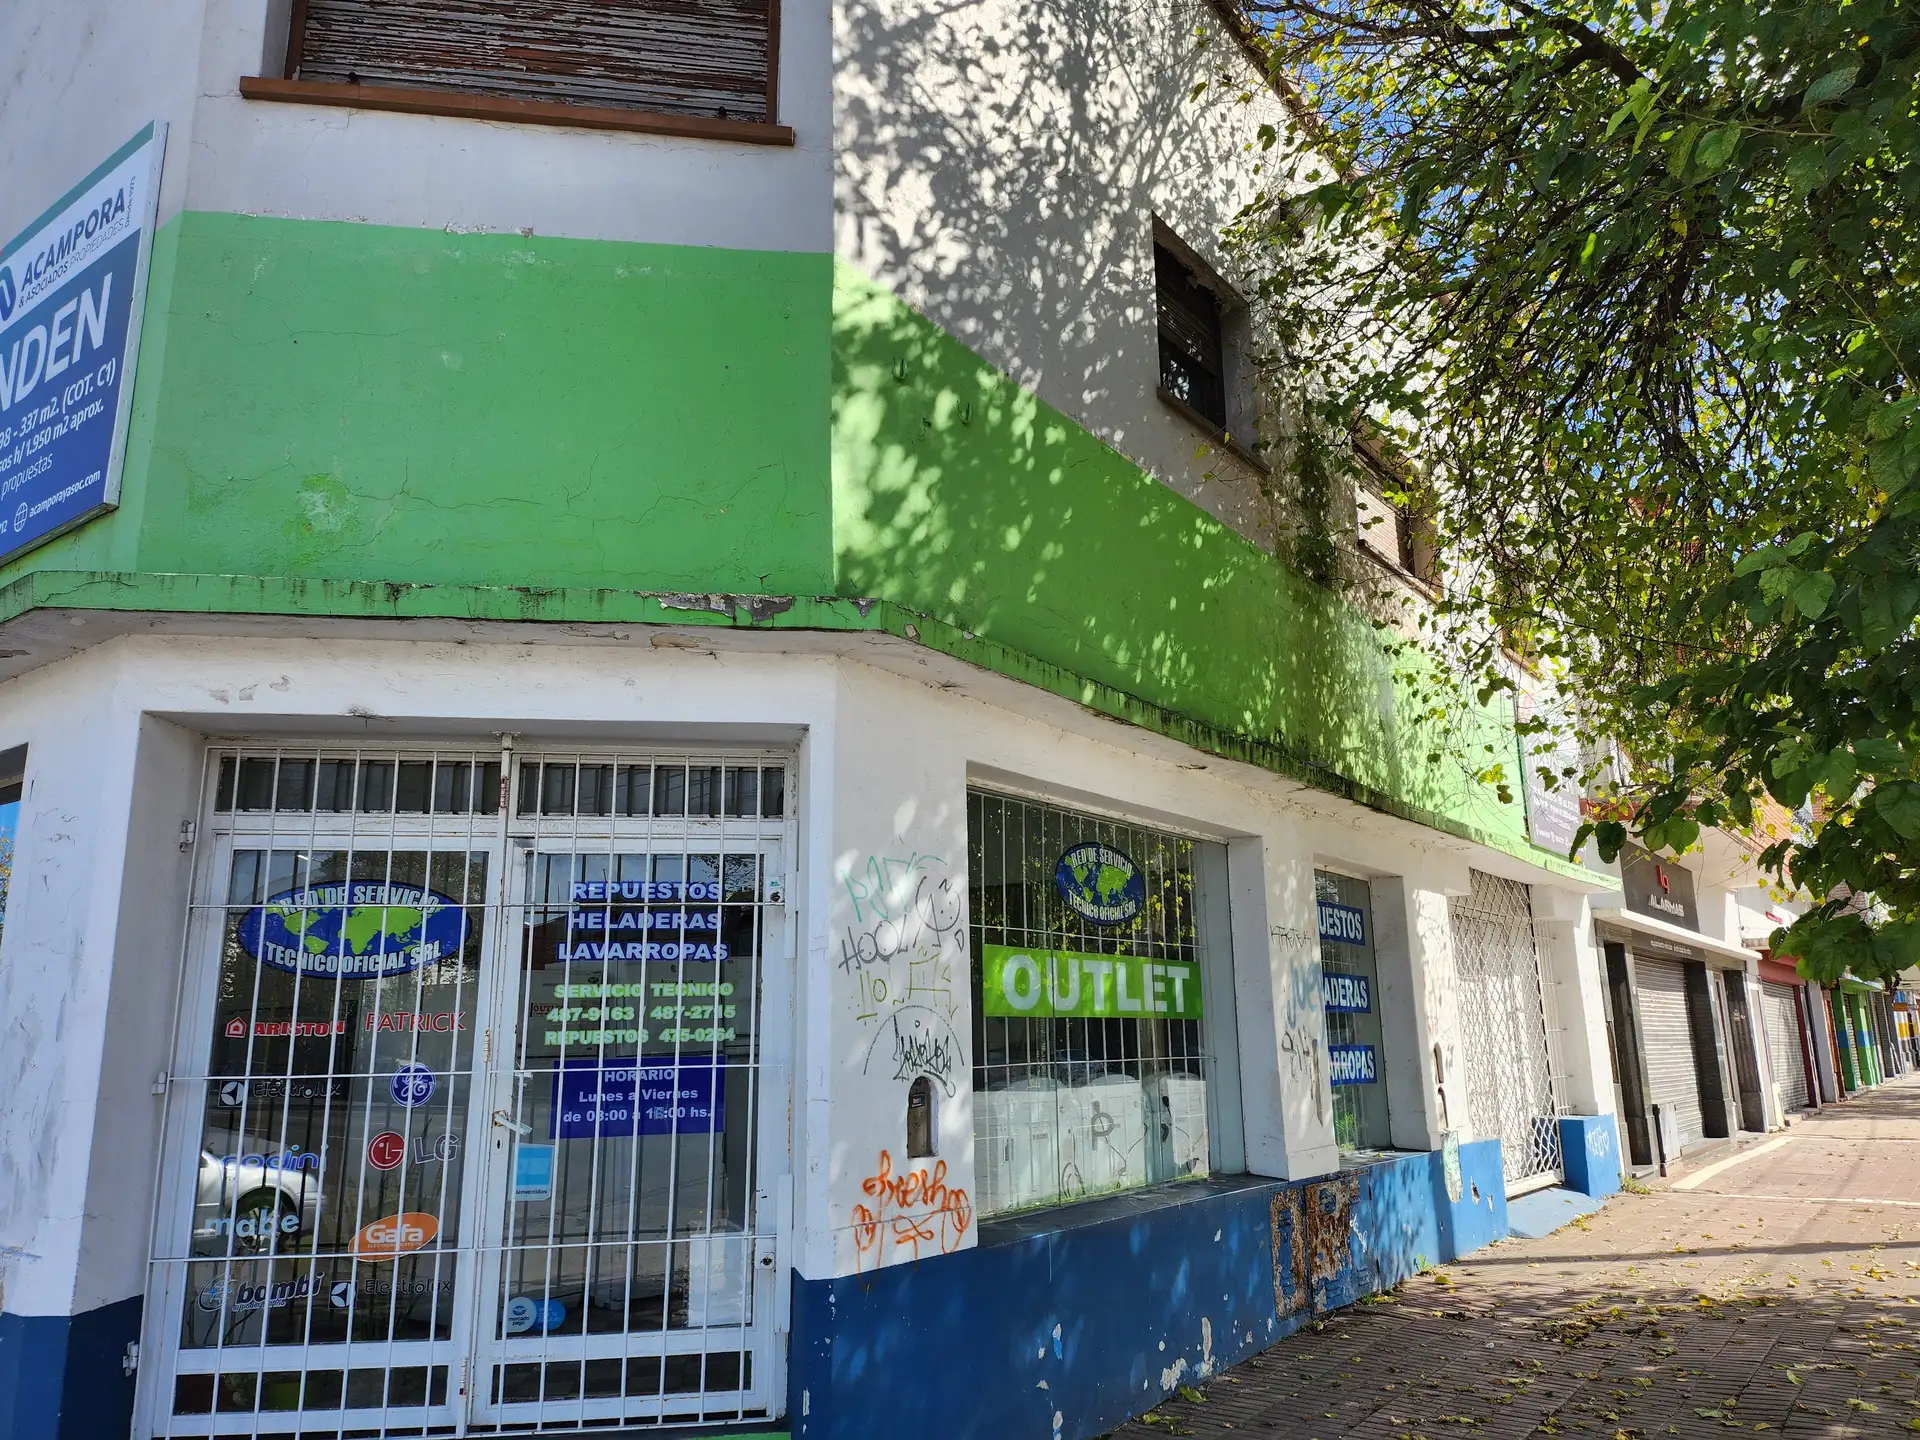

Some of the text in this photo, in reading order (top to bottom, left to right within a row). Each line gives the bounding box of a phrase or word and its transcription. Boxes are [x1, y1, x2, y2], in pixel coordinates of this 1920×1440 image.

[22, 188, 125, 292] ACAMPORA
[26, 260, 69, 304] ASOCIADOS
[69, 218, 125, 268] PROPIEDADES
[20, 408, 39, 437] 337
[39, 396, 59, 424] m2.
[62, 373, 93, 415] (COT.
[97, 357, 116, 386] C1)
[53, 415, 70, 440] m2
[70, 399, 104, 431] aprox.
[1, 453, 54, 501] propuestas
[29, 470, 101, 518] acamporayasoc.com
[1070, 847, 1133, 878] RED DE SERVICIO
[281, 884, 440, 915] RED DE SERVICIO
[571, 880, 724, 901] REPUESTOS
[1068, 888, 1137, 920] TECNICO OFICIAL SRL
[568, 911, 722, 930] HELADERAS
[1317, 905, 1363, 941] UESTOS
[265, 941, 442, 974] TECNICO OFICIAL SRL
[557, 942, 729, 961] LAVARROPAS
[553, 982, 735, 999] SERVICIO TECNICO
[1002, 954, 1190, 1012] OUTLET
[1323, 977, 1368, 1009] ADERAS
[255, 1012, 467, 1037] ARISTON PATRICK
[546, 1005, 635, 1022] 487-9163
[650, 1004, 737, 1020] 487-2715
[544, 1027, 736, 1046] REPUESTOS 475-0264
[252, 1080, 341, 1099] Electrolux
[603, 1068, 676, 1083] HORARIO
[579, 1089, 623, 1103] Lunes
[641, 1087, 698, 1101] Viernes
[563, 1110, 581, 1123] de
[690, 1106, 712, 1119] hs.
[413, 1133, 459, 1164] LG
[515, 1188, 548, 1196] ienvenidos
[205, 1207, 299, 1238] mabe
[366, 1223, 424, 1244] Gafa
[235, 1271, 325, 1304] bambi
[364, 1278, 451, 1295] Electrolux
